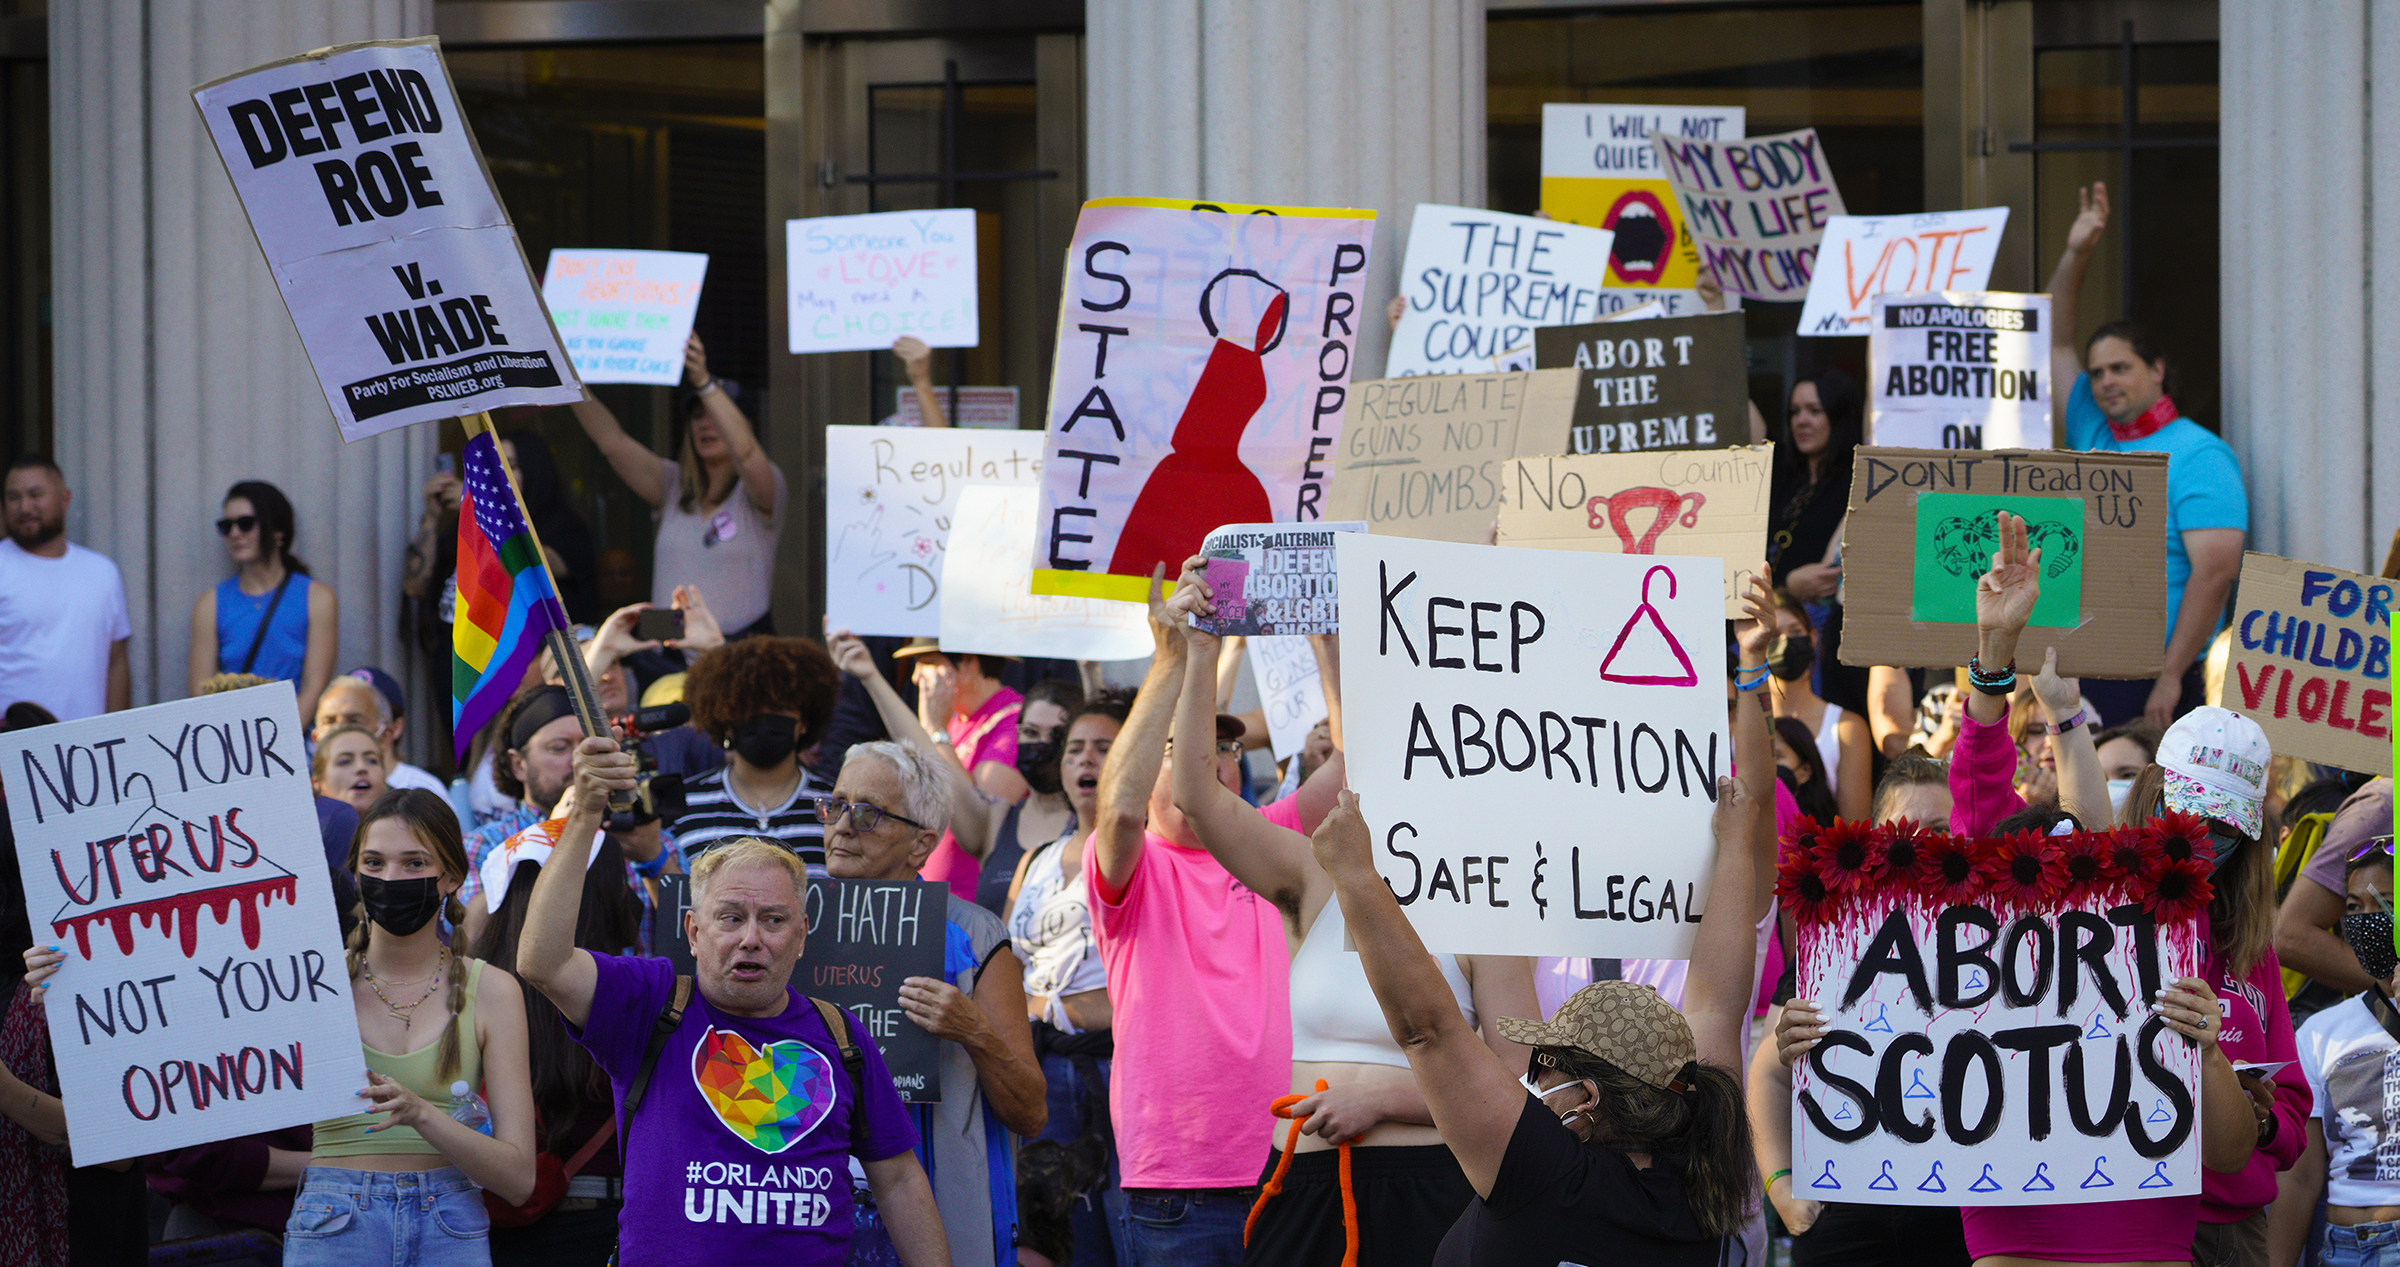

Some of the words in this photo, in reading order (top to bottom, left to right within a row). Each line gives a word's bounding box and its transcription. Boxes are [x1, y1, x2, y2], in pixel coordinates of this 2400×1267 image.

[227, 68, 443, 169] DEFEND
[1681, 116, 1726, 140] NOT
[313, 141, 445, 226] ROE
[1662, 137, 1723, 191] MY
[1724, 134, 1822, 191] BODY
[1684, 192, 1738, 238] MY
[1749, 188, 1830, 238] LIFE
[838, 250, 940, 285] LOVE
[1450, 222, 1566, 277] THE
[1705, 243, 1759, 292] MY
[1844, 226, 1988, 311] VOTE
[392, 262, 443, 300] v.
[364, 295, 509, 365] WADE
[1898, 307, 1924, 326] NO
[1928, 308, 2025, 331] APOLOGIES
[1574, 336, 1694, 370] ABORT
[1927, 331, 1998, 363] FREE
[352, 380, 389, 401] Party
[389, 375, 411, 392] For
[411, 365, 470, 388] Socialism
[473, 357, 496, 374] and
[499, 354, 547, 370] Liberation
[428, 373, 505, 401] PSLWEB.org
[1360, 377, 1519, 421] REGULATE
[1593, 374, 1659, 407] THE
[1886, 365, 2038, 400] ABORTION
[1048, 241, 1133, 571] STATE
[1350, 423, 1422, 458] GUNS
[1443, 418, 1508, 452] NOT
[1370, 460, 1497, 523] WOMBS
[1518, 458, 1587, 511] No
[1660, 453, 1769, 513] Country
[1993, 453, 2082, 493] Tread
[2096, 495, 2143, 529] US
[1379, 560, 1545, 674] KEEP
[22, 737, 127, 823] NOT
[148, 717, 295, 792] YOUR
[1403, 702, 1718, 802] ABORTION
[2188, 745, 2224, 769] SAN
[51, 807, 259, 906] UTERUS
[837, 882, 923, 946] HATH
[813, 964, 885, 988] UTERUS
[1839, 904, 2162, 1023] ABORT
[75, 973, 176, 1046] NOT
[199, 950, 339, 1019] YOUR
[849, 1003, 902, 1039] THE
[121, 1041, 303, 1121] OPINION
[1798, 1014, 2199, 1161] SCOTUS
[685, 1161, 833, 1190] #ORLANDO
[685, 1187, 831, 1227] UNITED
